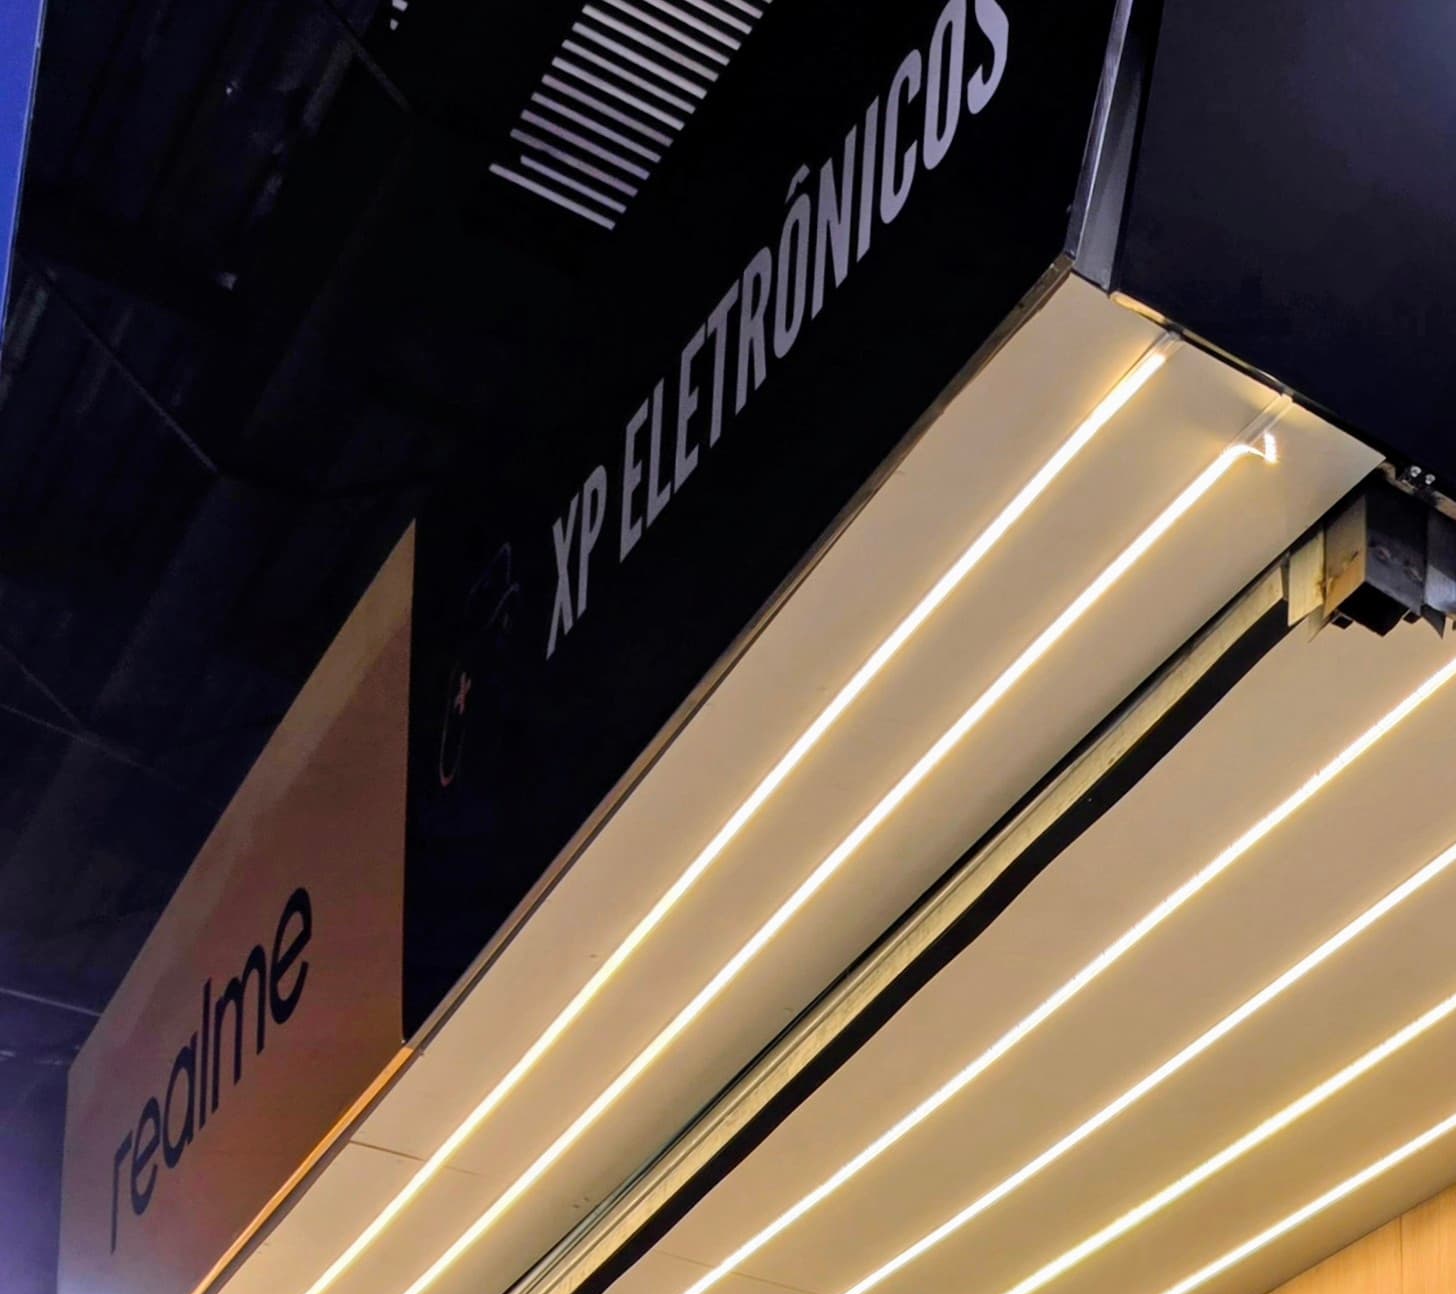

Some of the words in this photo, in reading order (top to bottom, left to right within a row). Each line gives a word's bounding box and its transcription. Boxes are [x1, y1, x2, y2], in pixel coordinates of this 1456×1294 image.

[546, 465, 608, 660] XP
[620, 0, 1009, 562] ELETRÔNICOS
[112, 887, 313, 1255] realme
